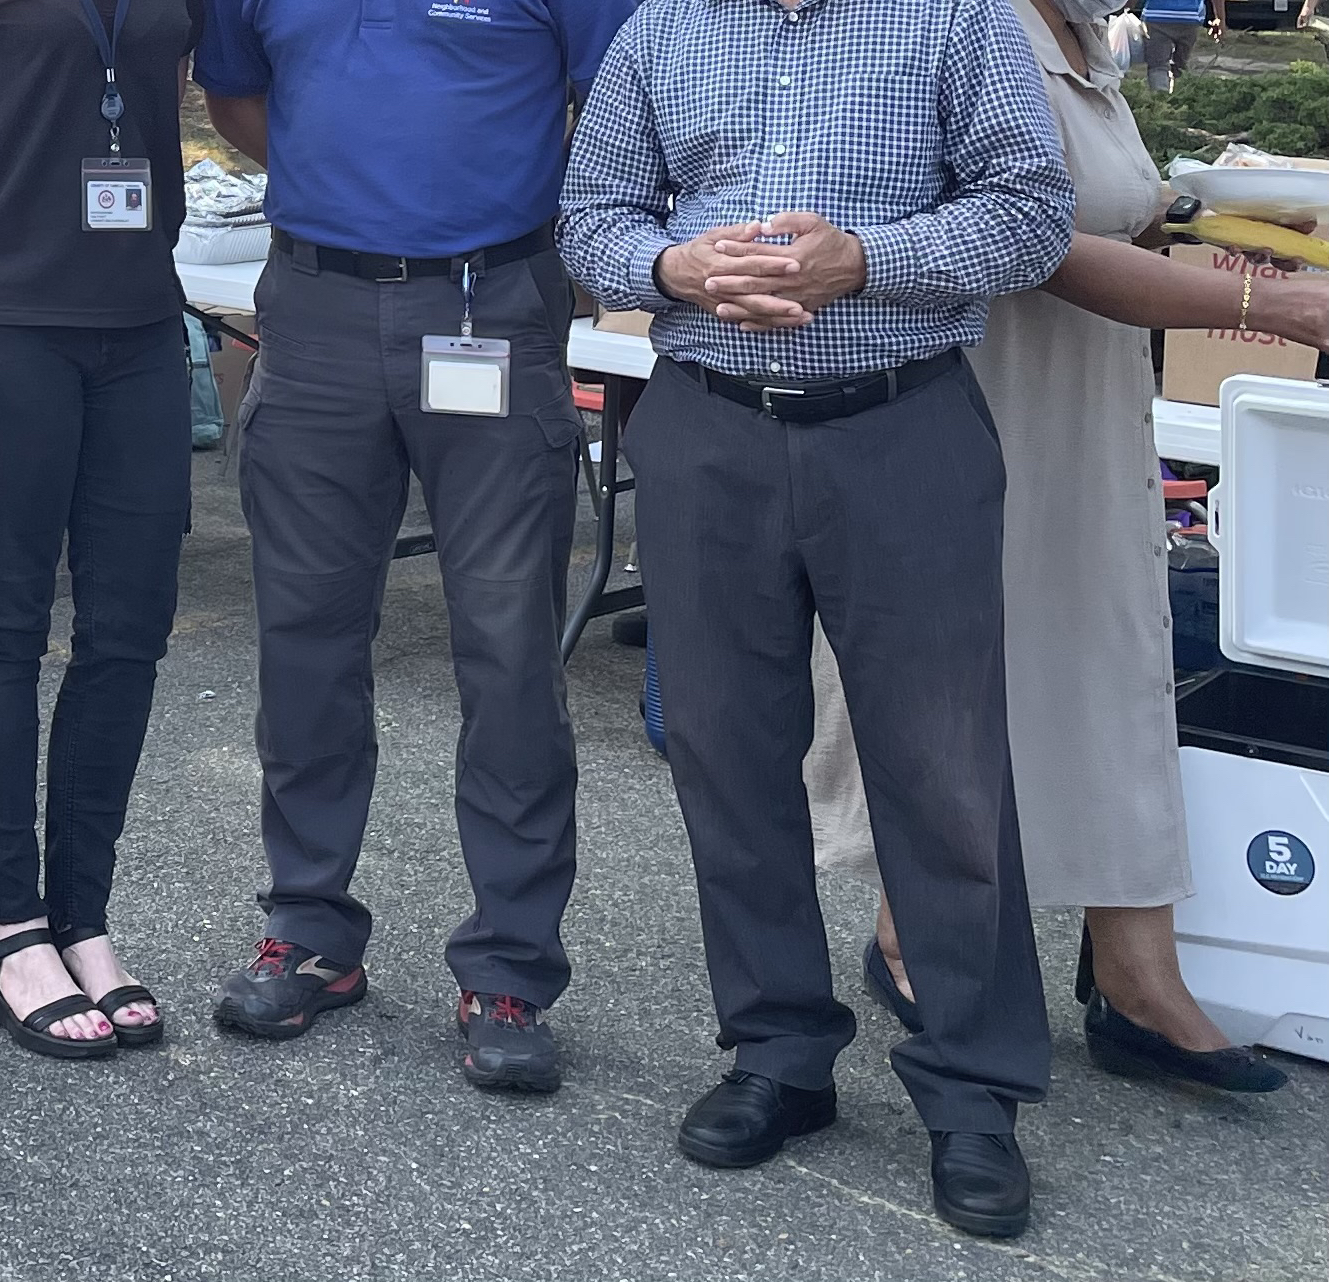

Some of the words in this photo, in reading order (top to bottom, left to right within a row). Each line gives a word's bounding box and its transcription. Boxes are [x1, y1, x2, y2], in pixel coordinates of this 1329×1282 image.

[432, 3, 476, 14] Neighborhood
[428, 9, 465, 20] Community
[465, 13, 492, 23] Services
[1268, 835, 1292, 862] 5
[1265, 861, 1298, 875] DAY
